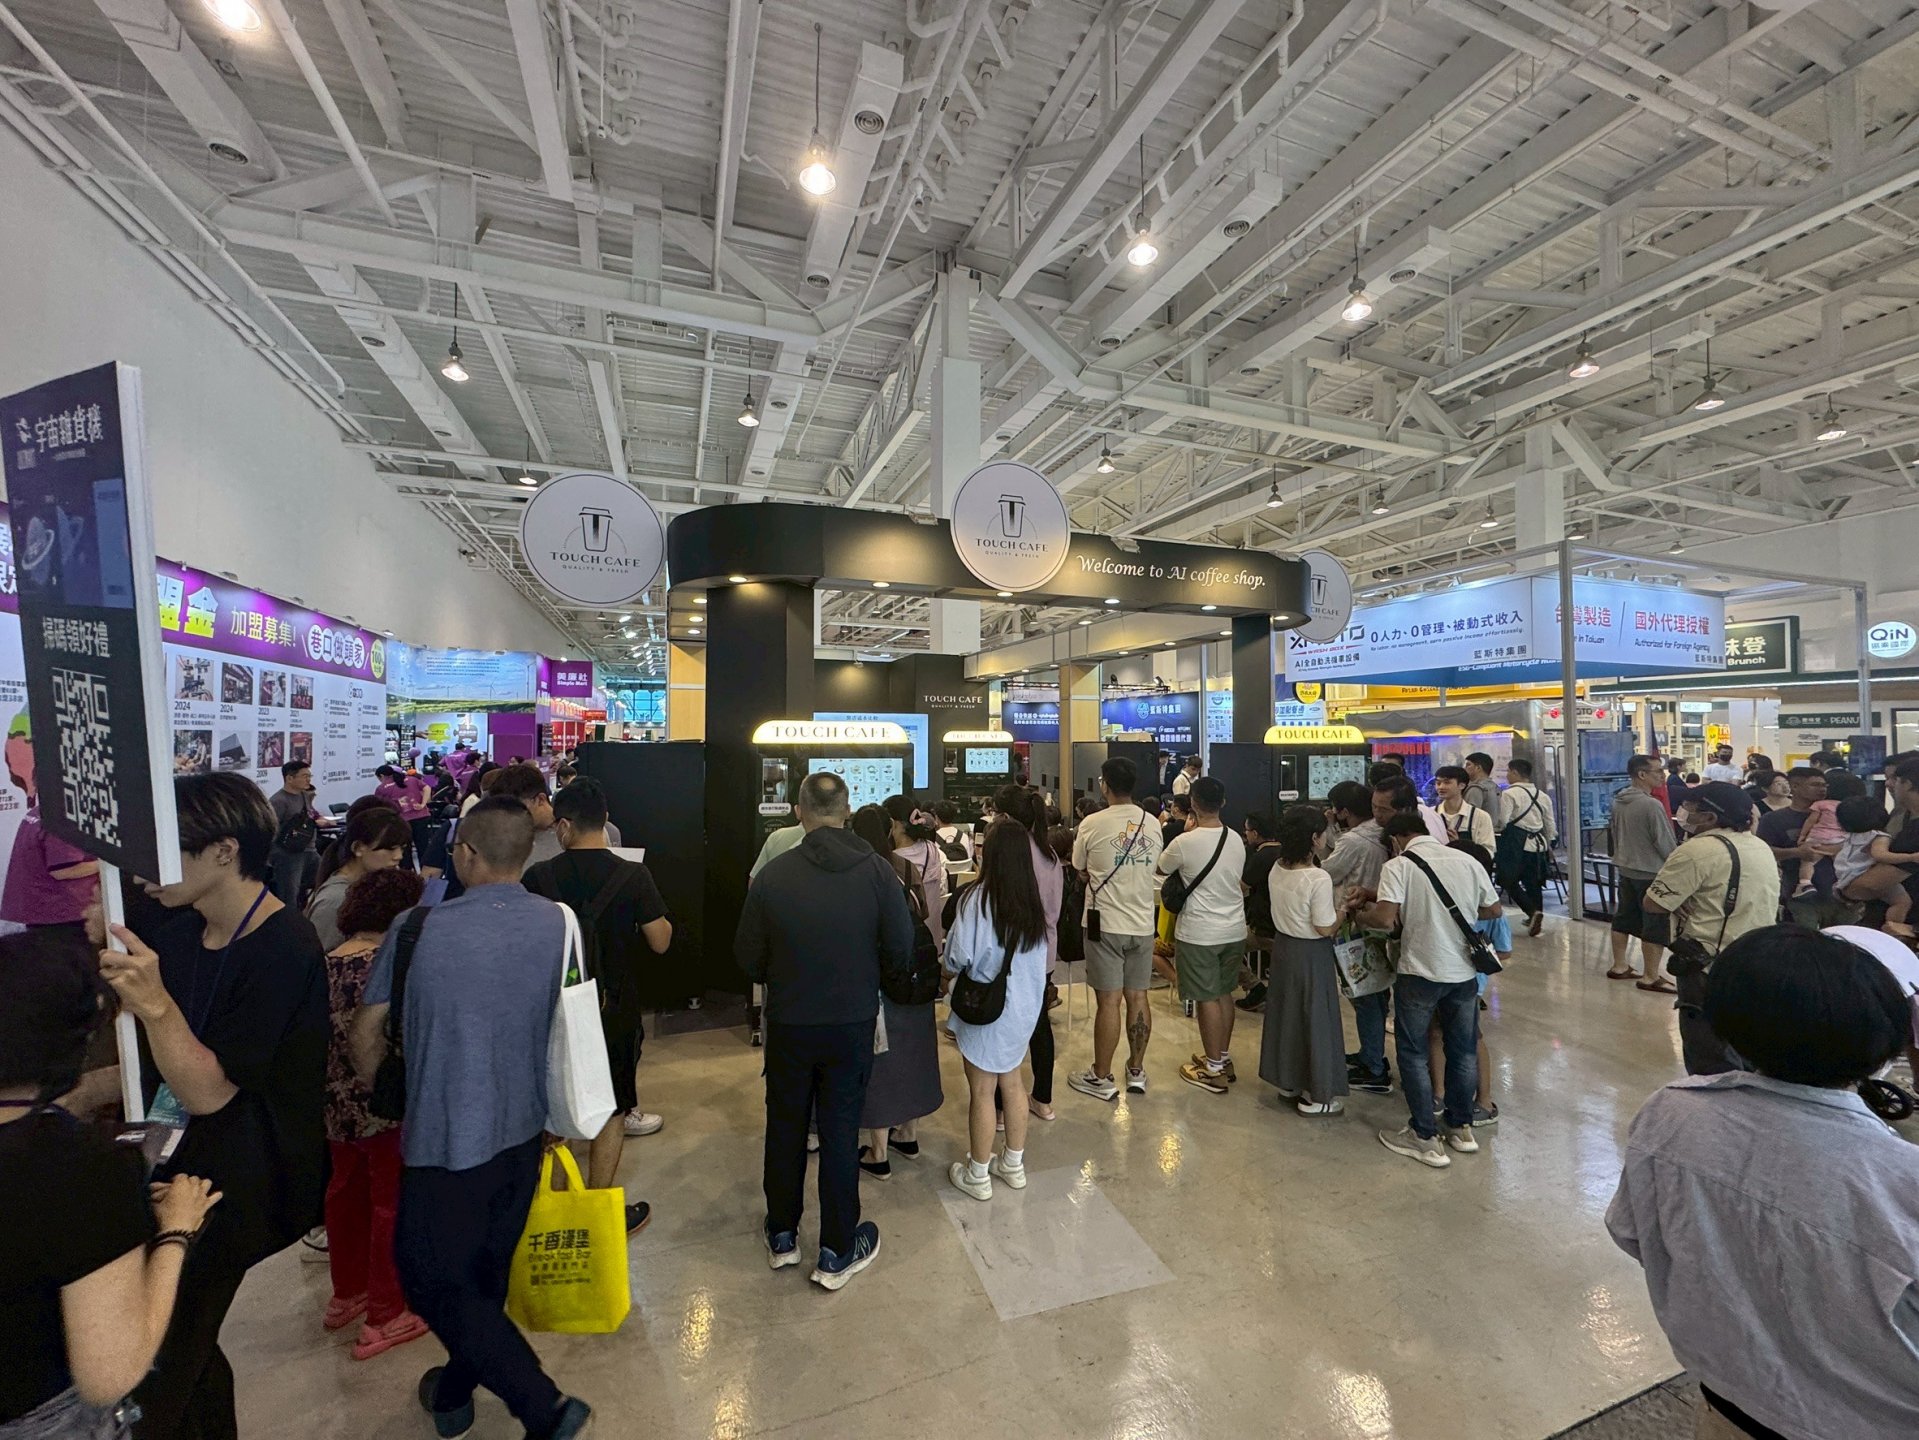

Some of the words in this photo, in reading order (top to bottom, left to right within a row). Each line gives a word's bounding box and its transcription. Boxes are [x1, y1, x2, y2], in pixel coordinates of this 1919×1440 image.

[976, 538, 1016, 549] TOUCH
[1019, 542, 1048, 552] CAFE
[549, 551, 600, 564] TOUCH
[604, 557, 640, 567] CAFE
[1077, 555, 1144, 577] Welcome
[1150, 564, 1163, 578] to
[1167, 567, 1186, 581] AI
[1190, 568, 1230, 585] coffee
[1233, 573, 1266, 590] shop.
[1322, 607, 1339, 616] CAFE
[230, 606, 297, 648] 加盟募集!
[1635, 611, 1710, 635] 國外代理授權
[1871, 628, 1909, 641] QiN
[310, 629, 363, 664] 巷口做頭家
[1635, 638, 1663, 648] Authorized
[1727, 656, 1766, 665] Brunch
[556, 672, 588, 681] 美廉社
[923, 695, 956, 703] TOUCH
[174, 701, 191, 711] 2024
[220, 704, 233, 712] 2024
[772, 725, 837, 738] TOUCH
[844, 726, 890, 738] CAFE
[1277, 730, 1318, 739] TOUCH
[1322, 730, 1352, 739] CAFE
[529, 1229, 590, 1252] 千香漢堡
